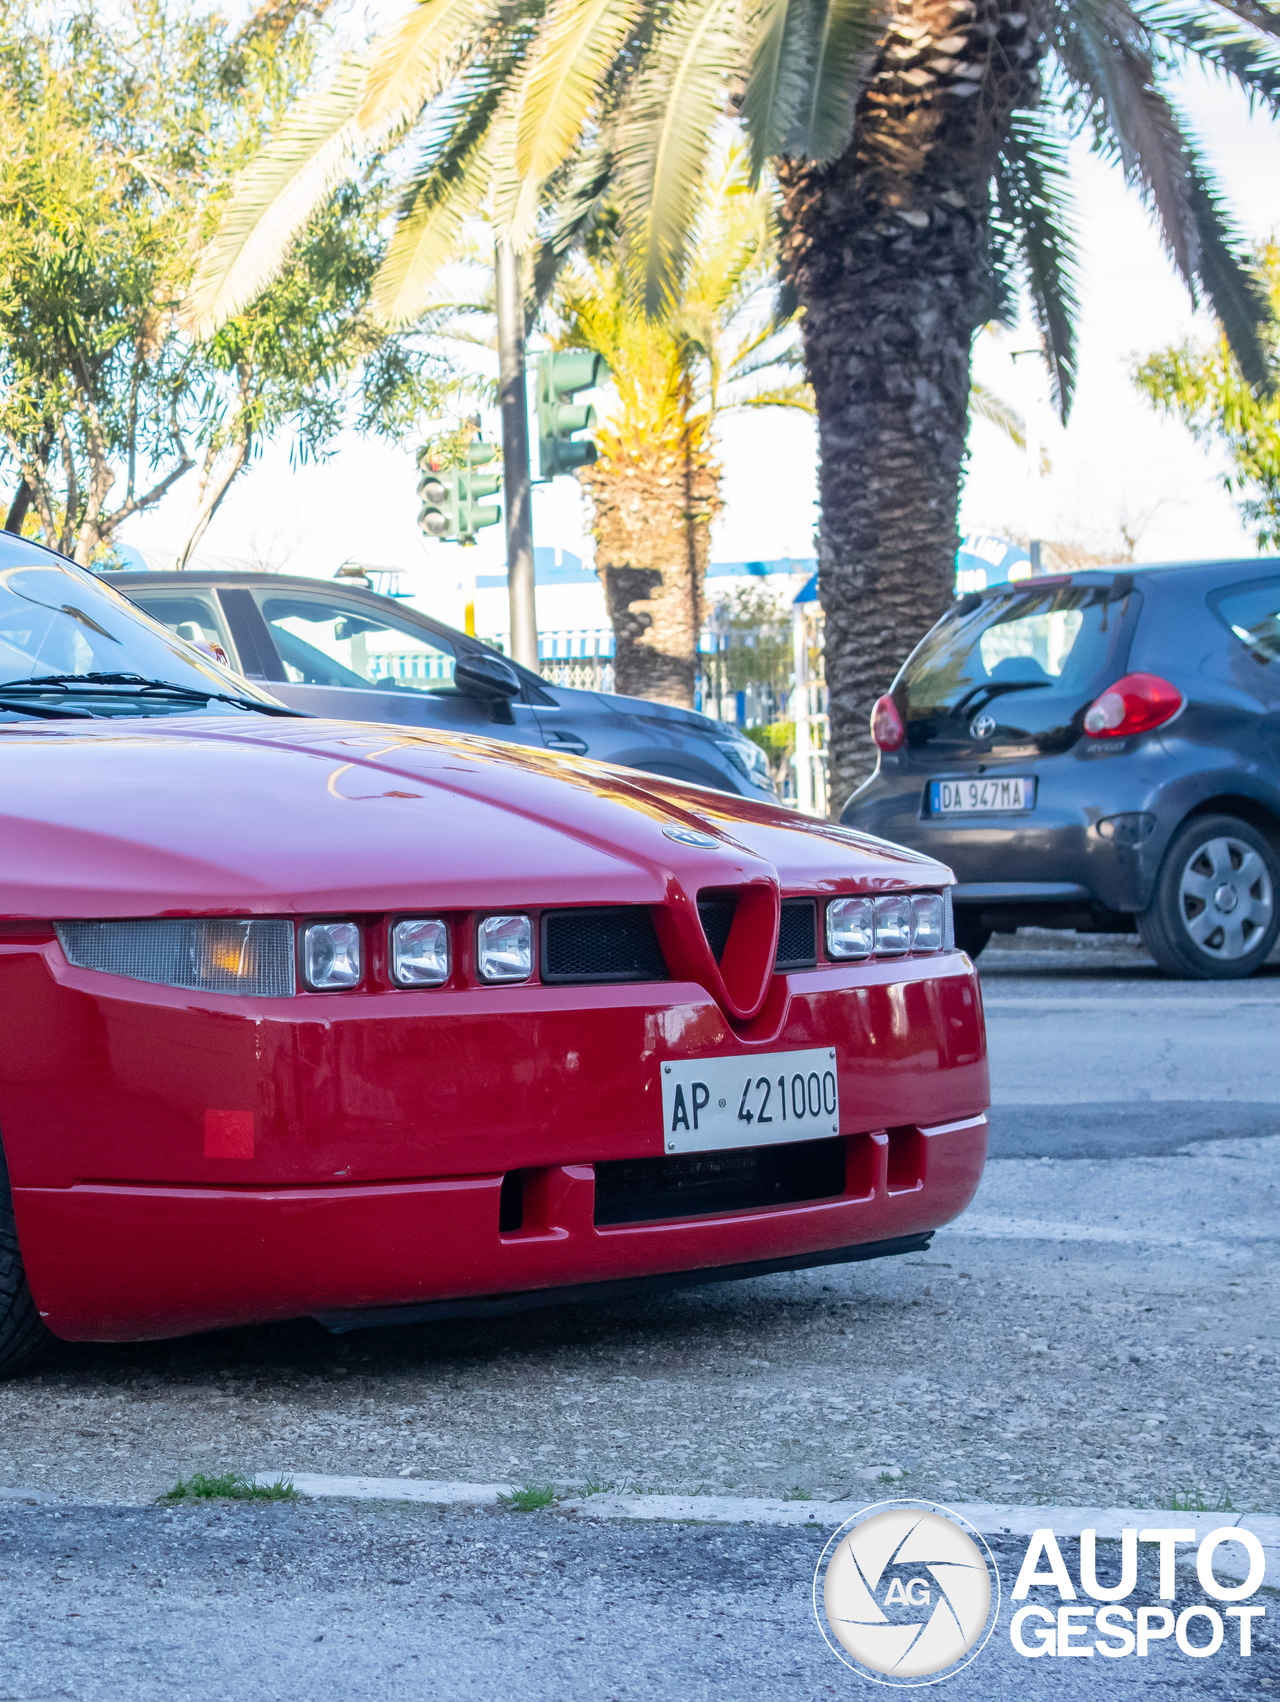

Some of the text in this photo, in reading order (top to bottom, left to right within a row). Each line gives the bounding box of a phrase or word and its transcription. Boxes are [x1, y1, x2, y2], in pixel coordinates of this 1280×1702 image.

[942, 781, 1022, 809] DA 947MA
[671, 1070, 837, 1131] AP 421000
